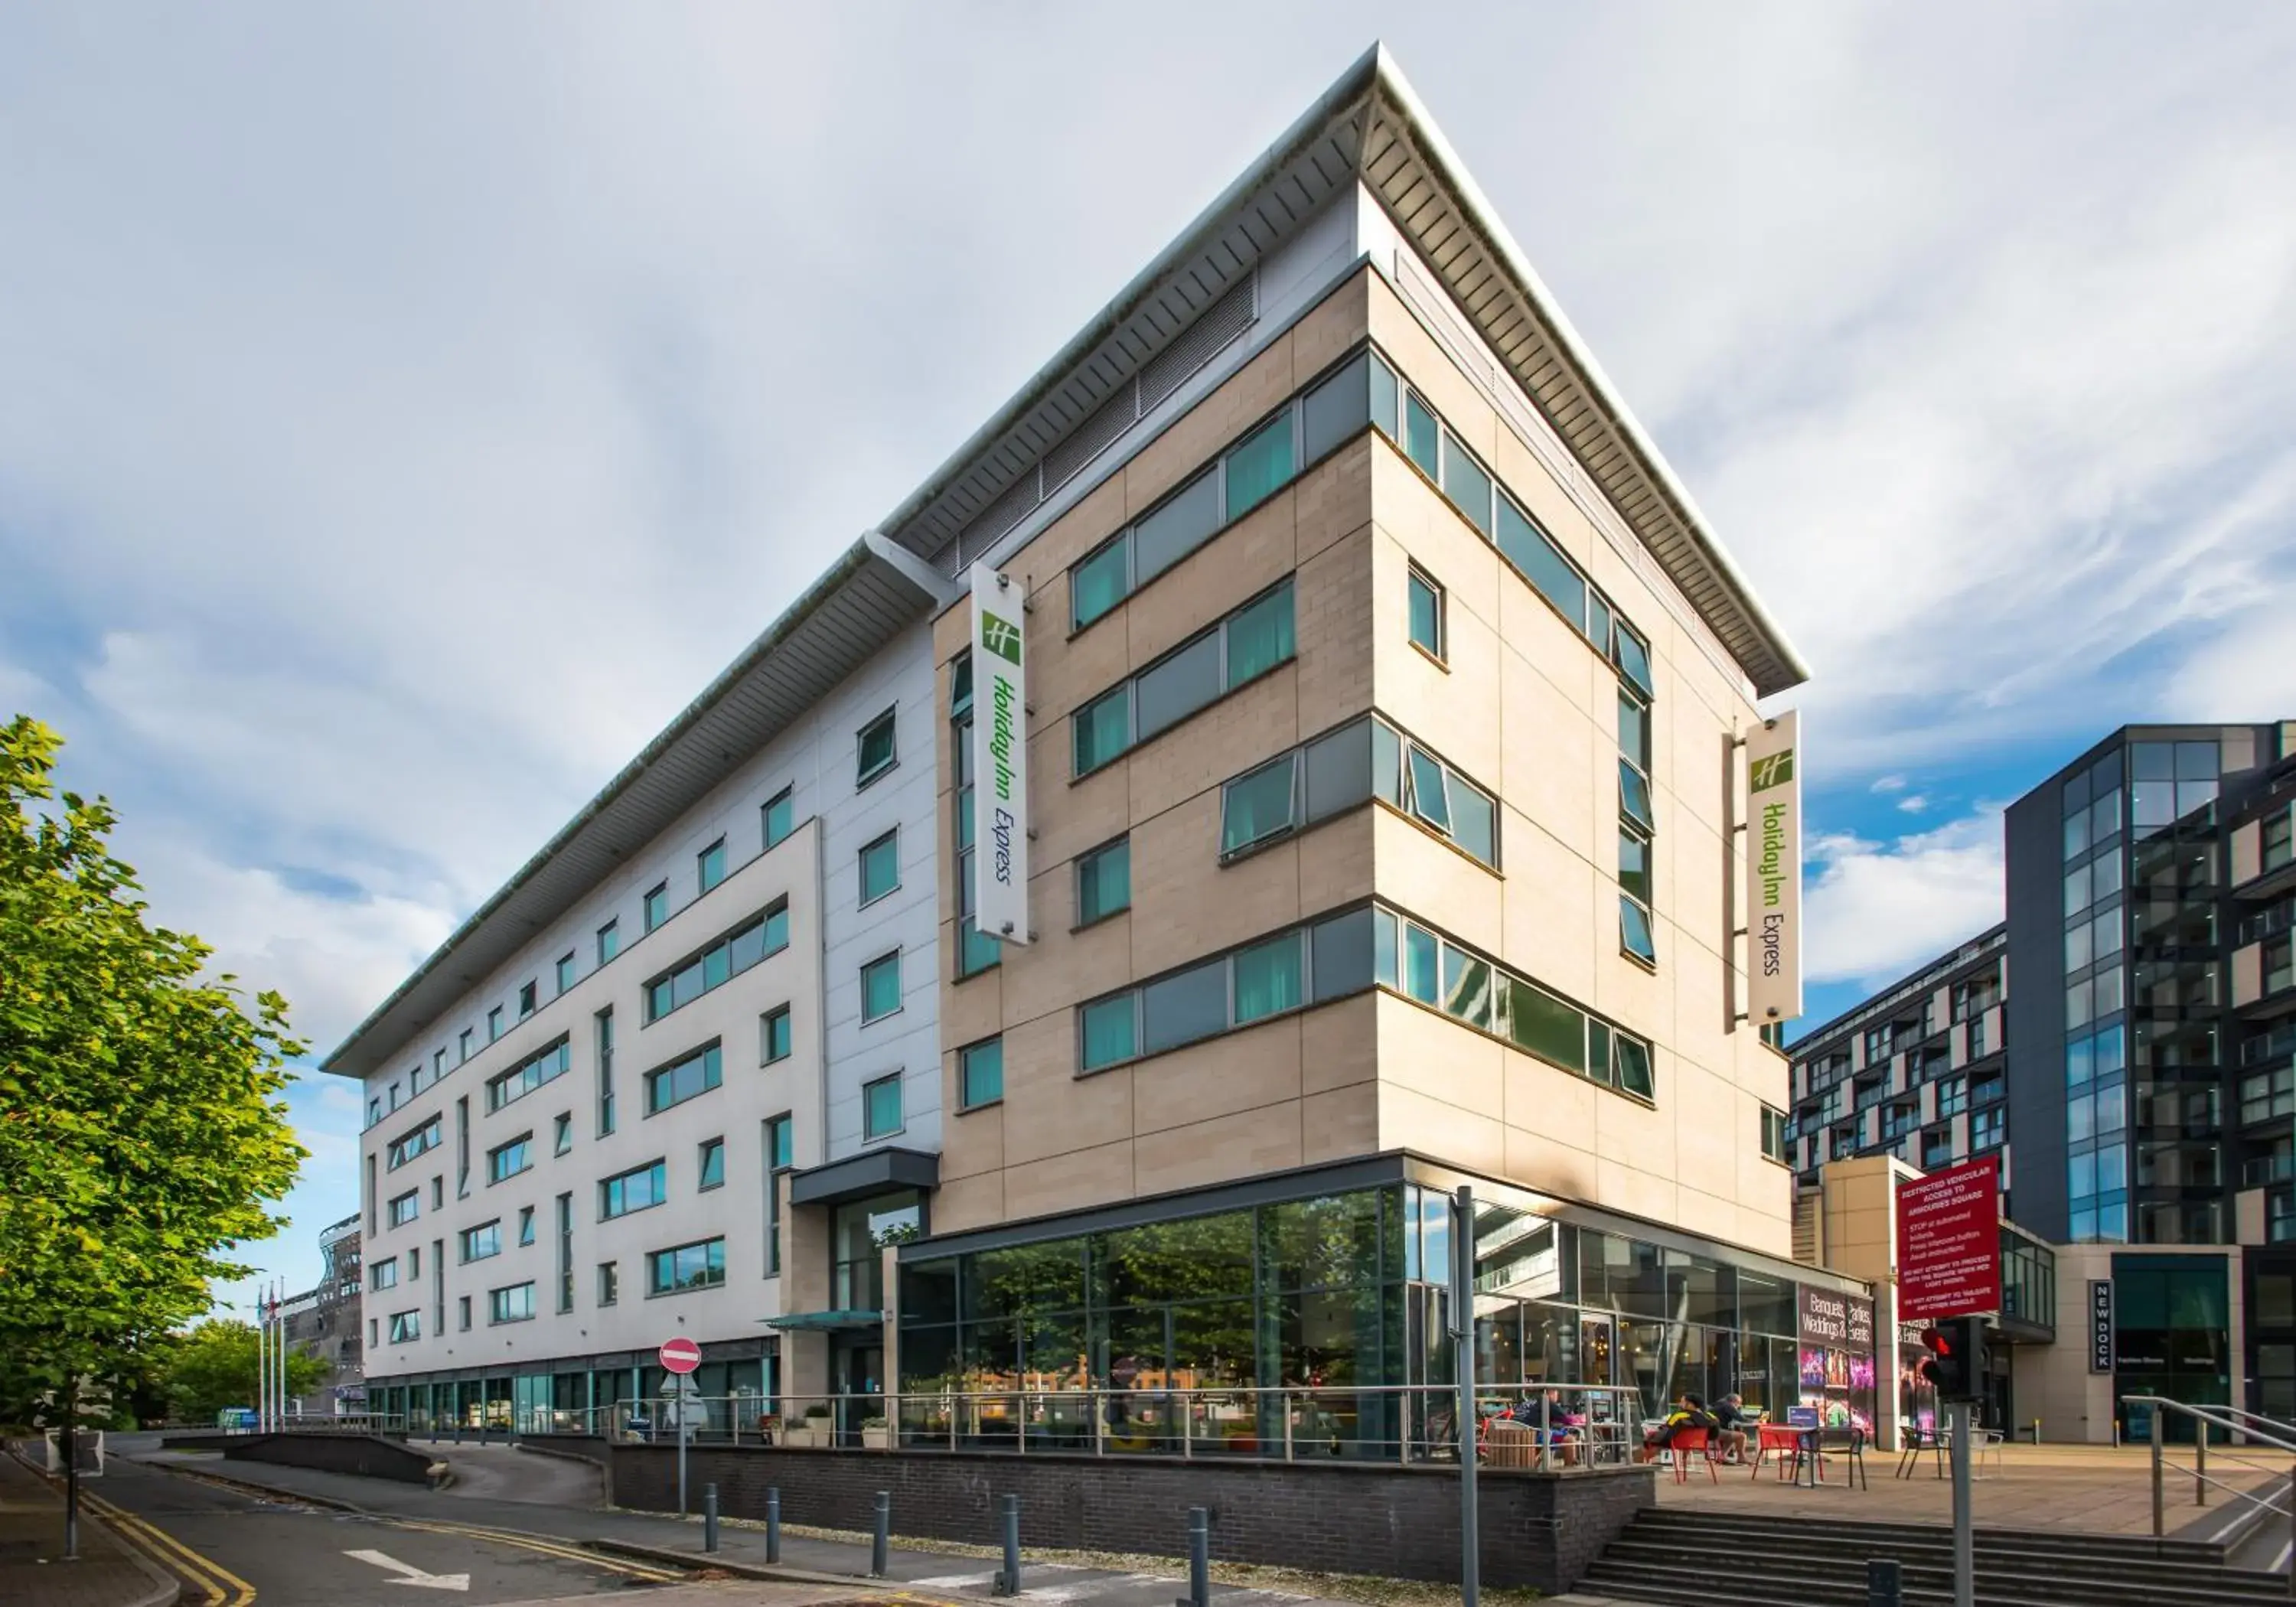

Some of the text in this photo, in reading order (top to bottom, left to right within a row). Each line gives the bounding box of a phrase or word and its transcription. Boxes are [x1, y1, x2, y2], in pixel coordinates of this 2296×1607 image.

[990, 674, 1016, 886] Holiday Inn Express
[1758, 803, 1787, 977] Holiday Inn Express
[1902, 1167, 1990, 1198] RESTRICTED VEHICULAR
[1923, 1184, 1965, 1202] ACCESS TO
[1908, 1191, 1982, 1216] ARMOURIES SQUARE
[1910, 1222, 1926, 1232] STOP
[1802, 1312, 1838, 1340] Weddings
[2097, 1286, 2108, 1366] NEW DOCK
